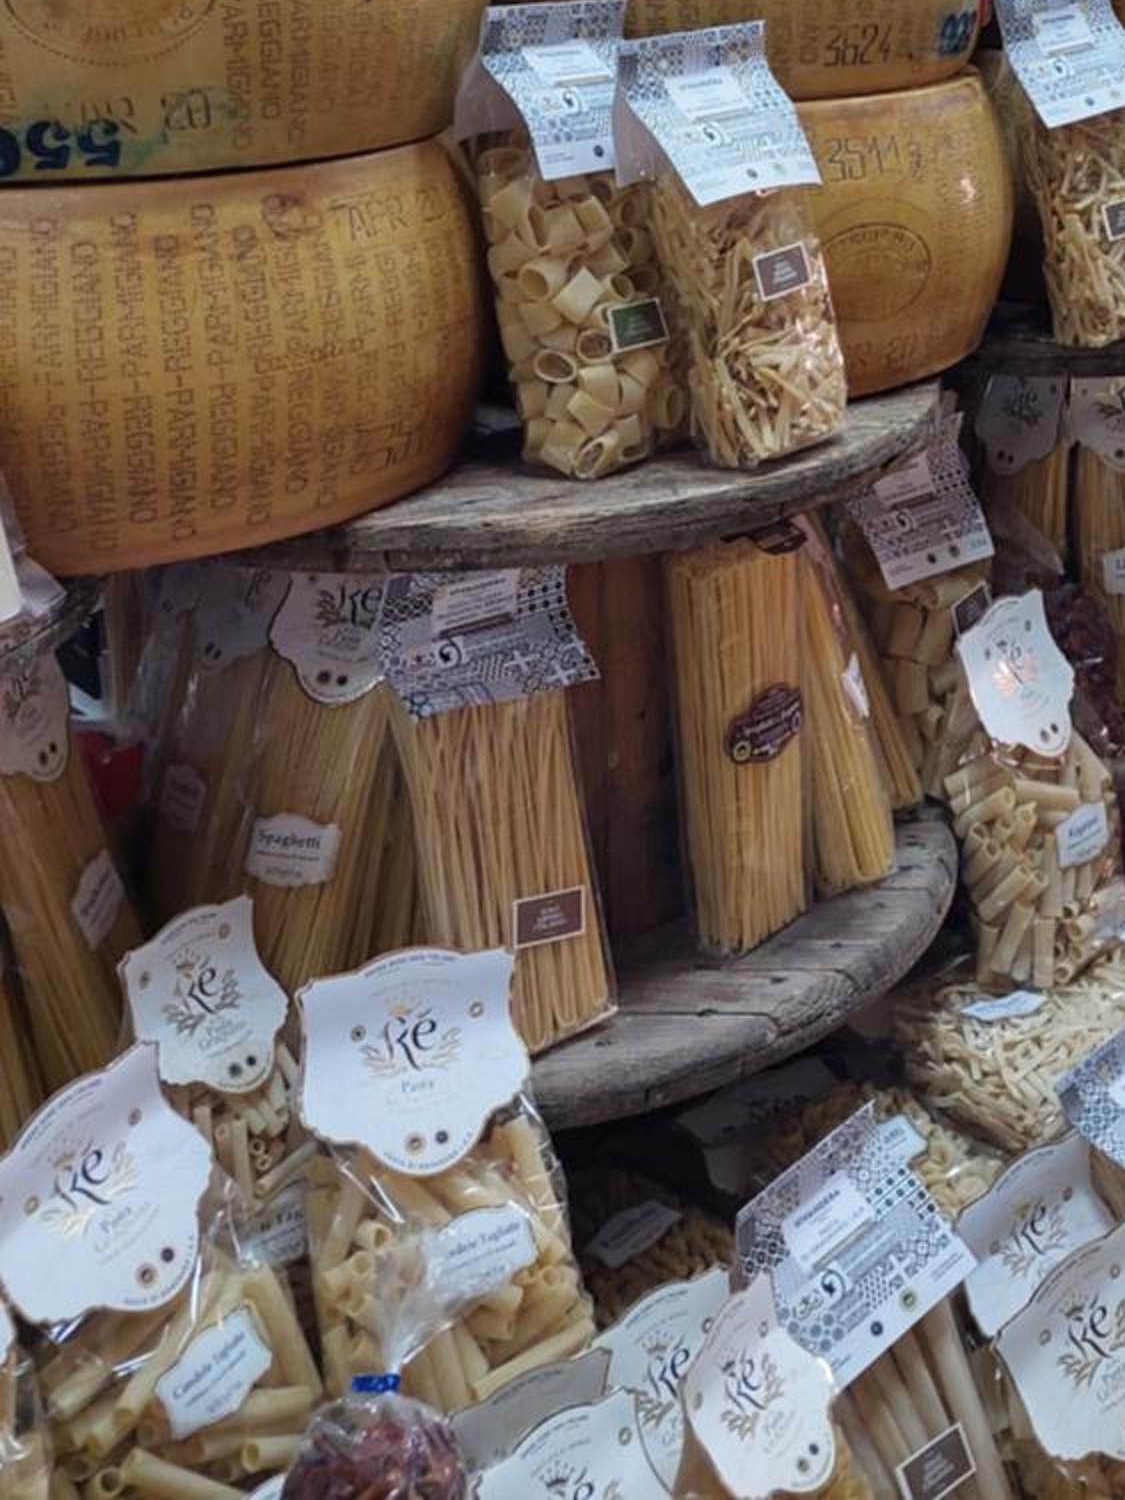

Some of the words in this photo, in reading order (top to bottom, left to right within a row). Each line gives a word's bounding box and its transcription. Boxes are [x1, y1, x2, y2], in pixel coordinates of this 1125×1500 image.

[70, 240, 105, 381] REGGIANO
[108, 211, 151, 377] PARMIGIANO
[153, 234, 192, 371] REGGIANO
[190, 203, 233, 367] PARMIGIANO
[127, 396, 159, 522] REGGIANO
[208, 384, 239, 508] REGGIANO
[257, 828, 323, 852] Spaghetti
